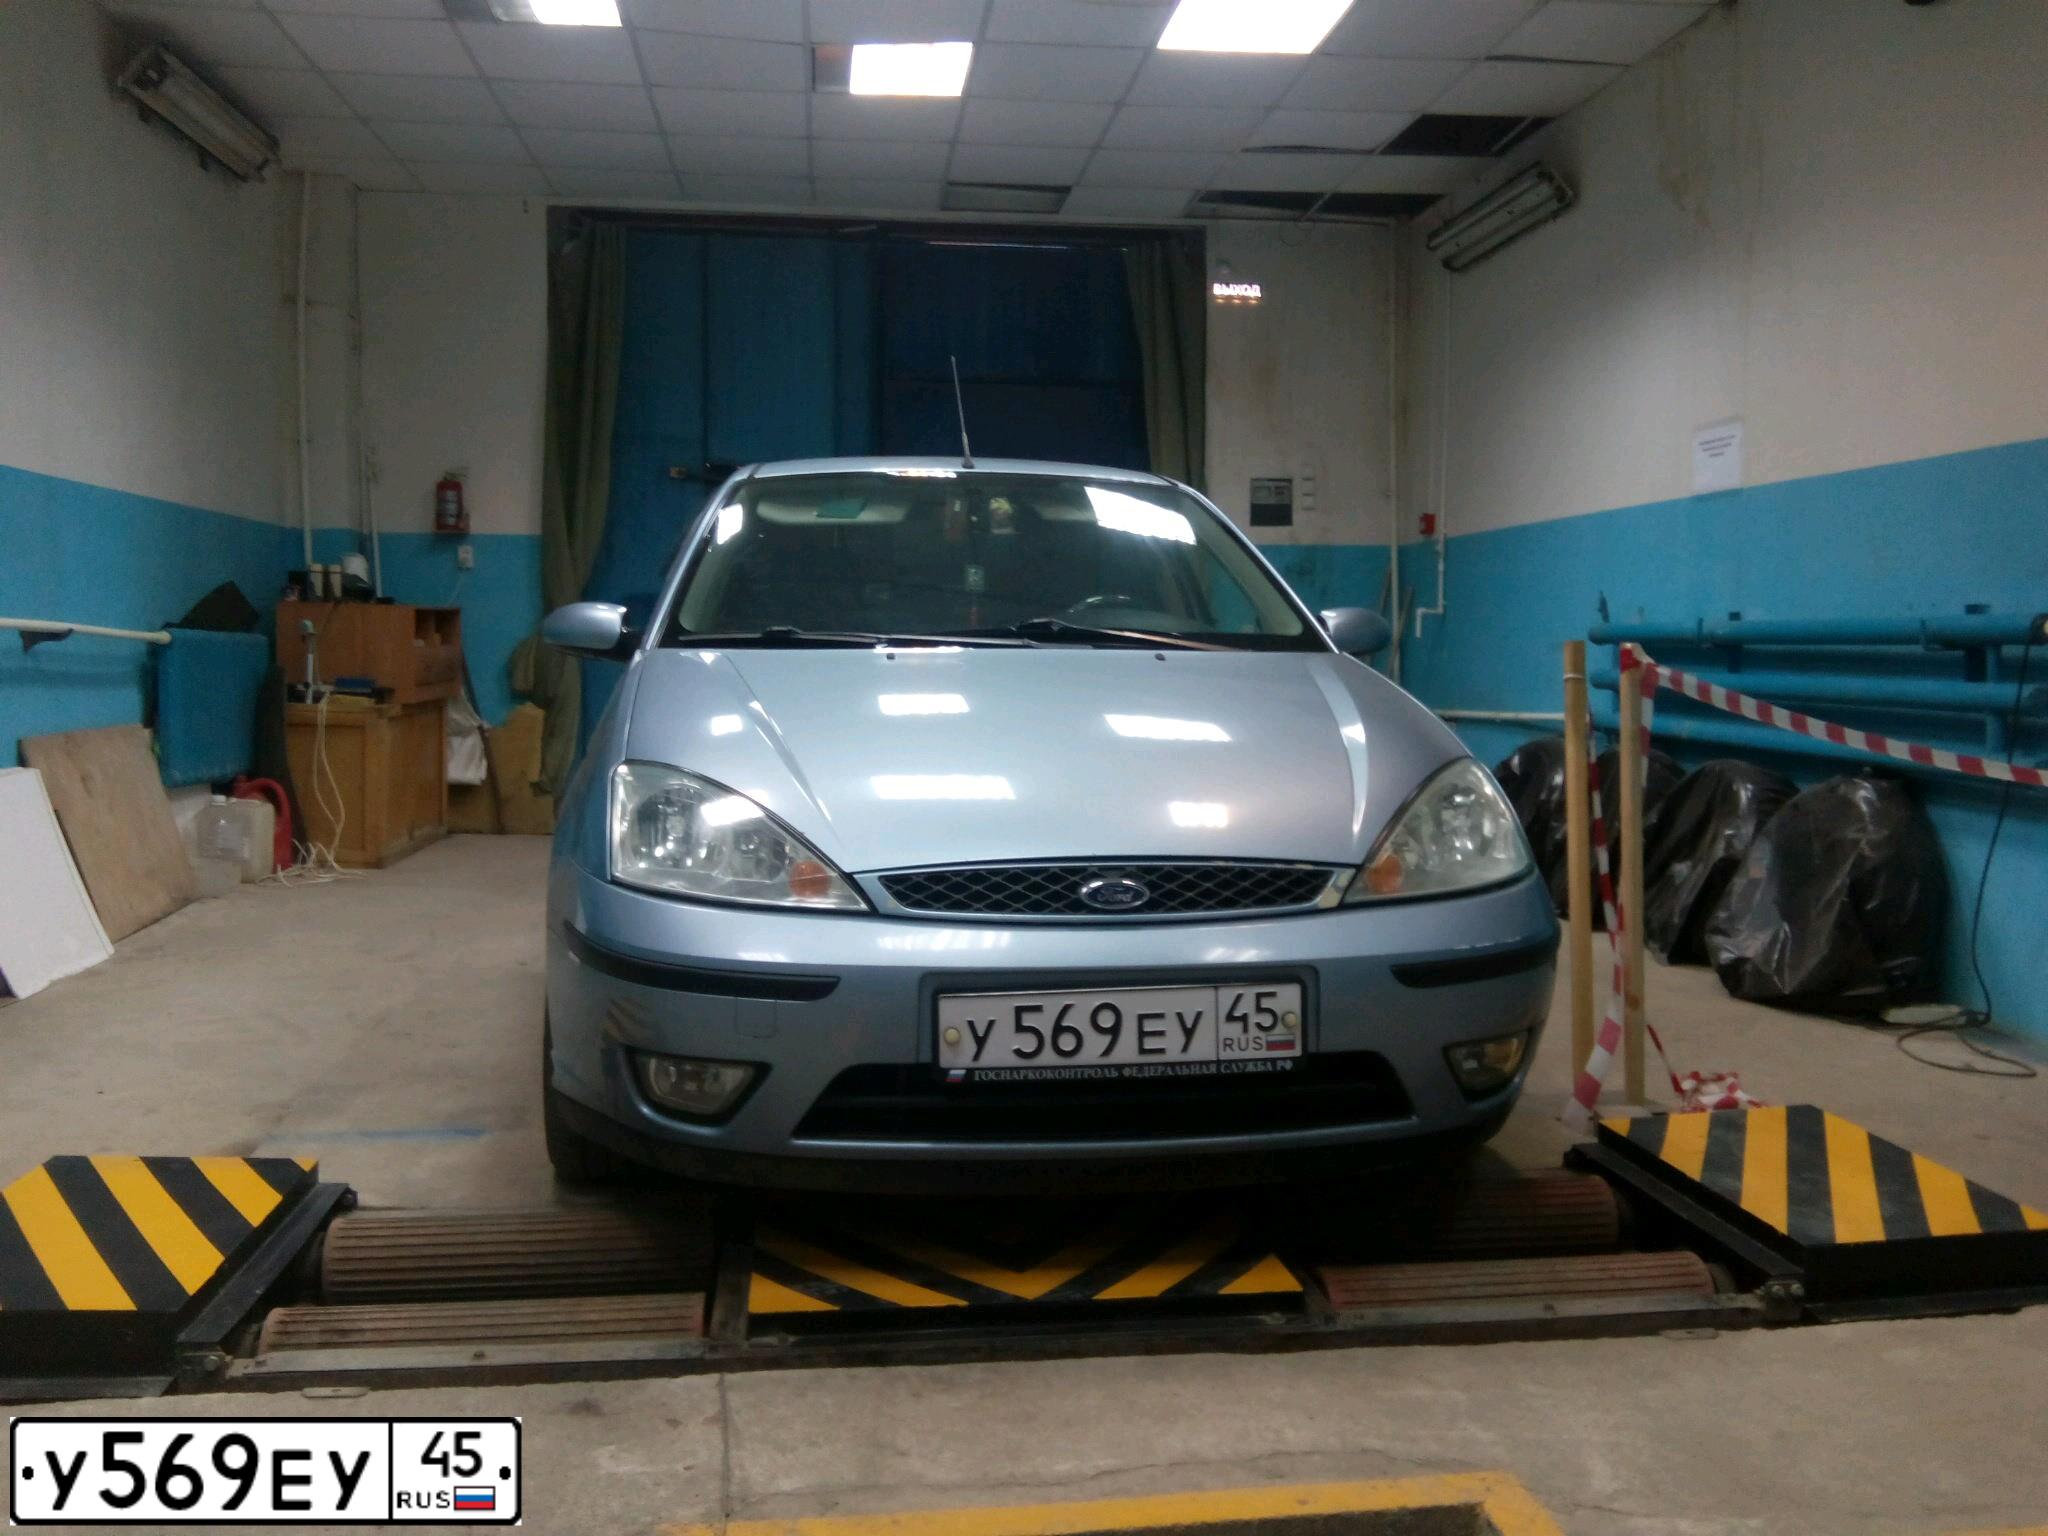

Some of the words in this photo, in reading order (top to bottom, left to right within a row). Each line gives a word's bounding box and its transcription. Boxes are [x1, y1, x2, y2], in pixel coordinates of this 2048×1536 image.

[1225, 991, 1281, 1033] 45
[1223, 1035, 1264, 1053] RUS
[974, 1066, 1119, 1081] ГОСНАРКОКОНТРОЛЬ
[1122, 1063, 1217, 1078] ФЕДЕРАЛЬНАЯ
[1221, 1061, 1274, 1075] СЛУЖБА
[1277, 1059, 1294, 1072] РФ
